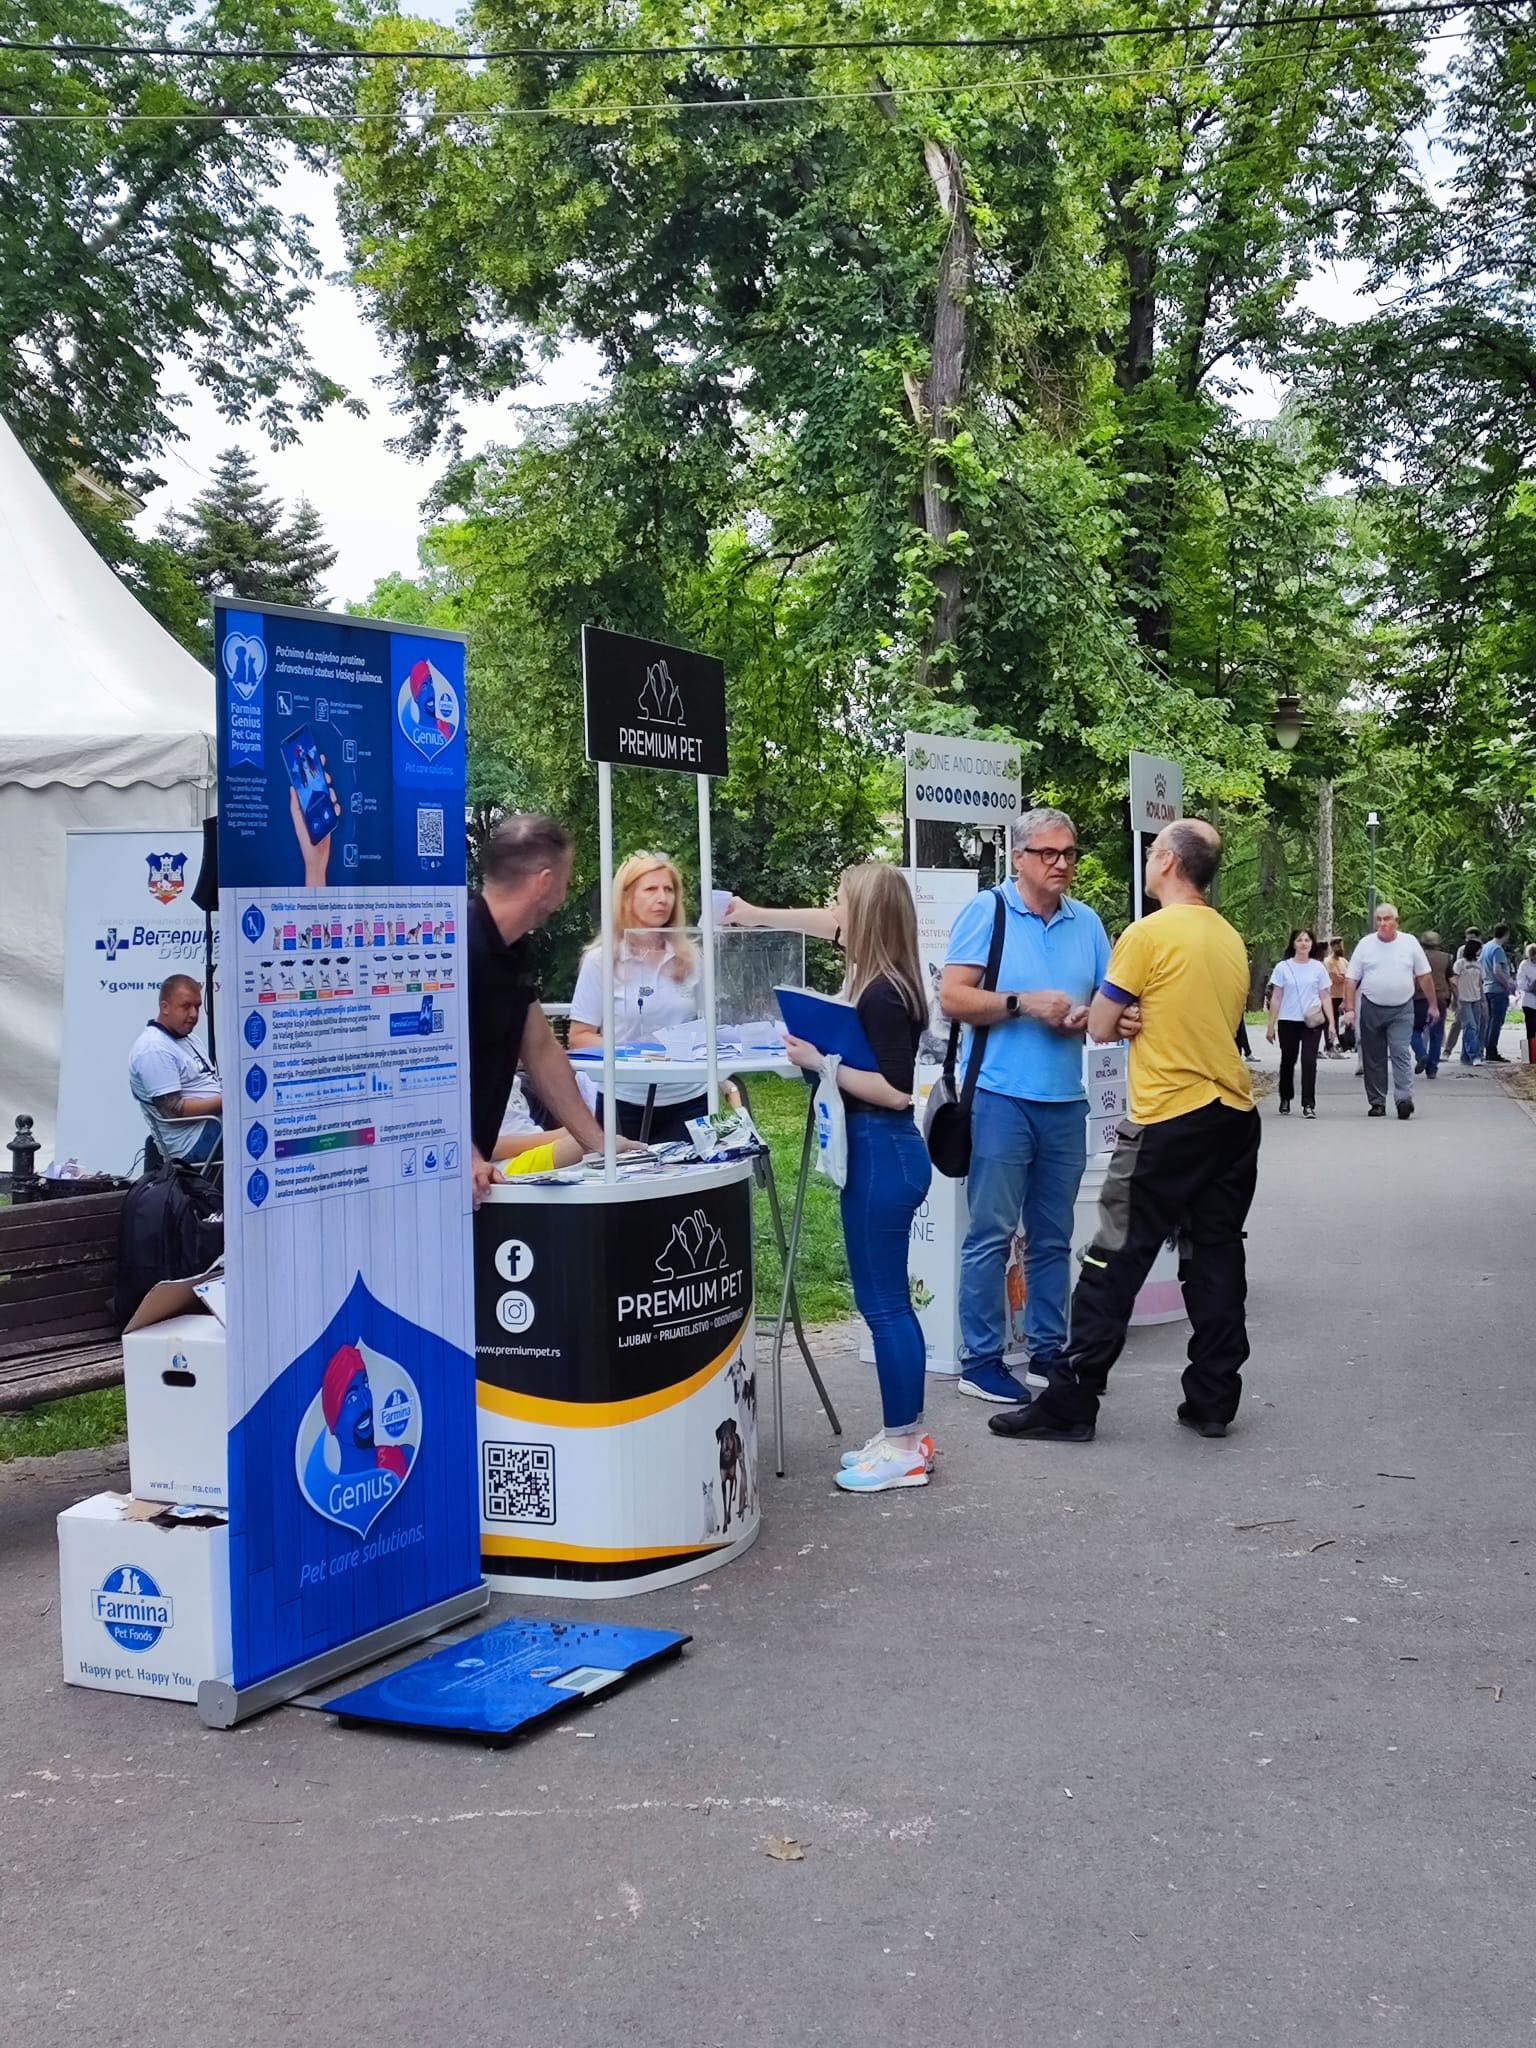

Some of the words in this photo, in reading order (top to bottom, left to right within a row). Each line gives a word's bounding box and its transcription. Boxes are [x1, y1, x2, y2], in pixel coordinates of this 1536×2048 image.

[275, 645, 305, 659] Počnimo
[305, 648, 314, 661] da
[314, 651, 340, 664] zajedno
[340, 655, 366, 667] pratimo
[275, 662, 315, 676] zdravstveni
[314, 666, 335, 679] status
[335, 669, 355, 683] Vašeg
[230, 702, 262, 716] Farmina
[231, 714, 262, 729] Genius
[231, 729, 245, 740] Pet
[244, 730, 262, 741] Care
[412, 728, 446, 746] Genius
[619, 727, 678, 760] PREMIUM
[680, 736, 703, 763] PET
[231, 740, 262, 753] Program
[929, 753, 951, 771] ONE
[953, 756, 974, 774] AND
[975, 758, 1001, 777] DONE
[617, 1279, 718, 1322] PREMIUM
[721, 1269, 743, 1301] PET
[618, 1332, 652, 1348] LJUBAV
[659, 1320, 710, 1342] PRIJATELJSTVO
[475, 1345, 561, 1358] www.premiumpet.rs
[381, 1405, 412, 1424] Farmina
[149, 1480, 222, 1495] www.fna.com
[329, 1473, 393, 1515] Genius
[300, 1559, 326, 1588] Pet
[329, 1549, 359, 1576] care
[362, 1524, 425, 1563] solutions.
[97, 1595, 168, 1623] Farmina
[114, 1627, 128, 1639] Pet
[129, 1629, 153, 1641] Foods
[80, 1661, 112, 1679] Happy
[115, 1668, 134, 1680] pet.
[137, 1668, 170, 1686] Happy
[172, 1672, 195, 1687] You.
